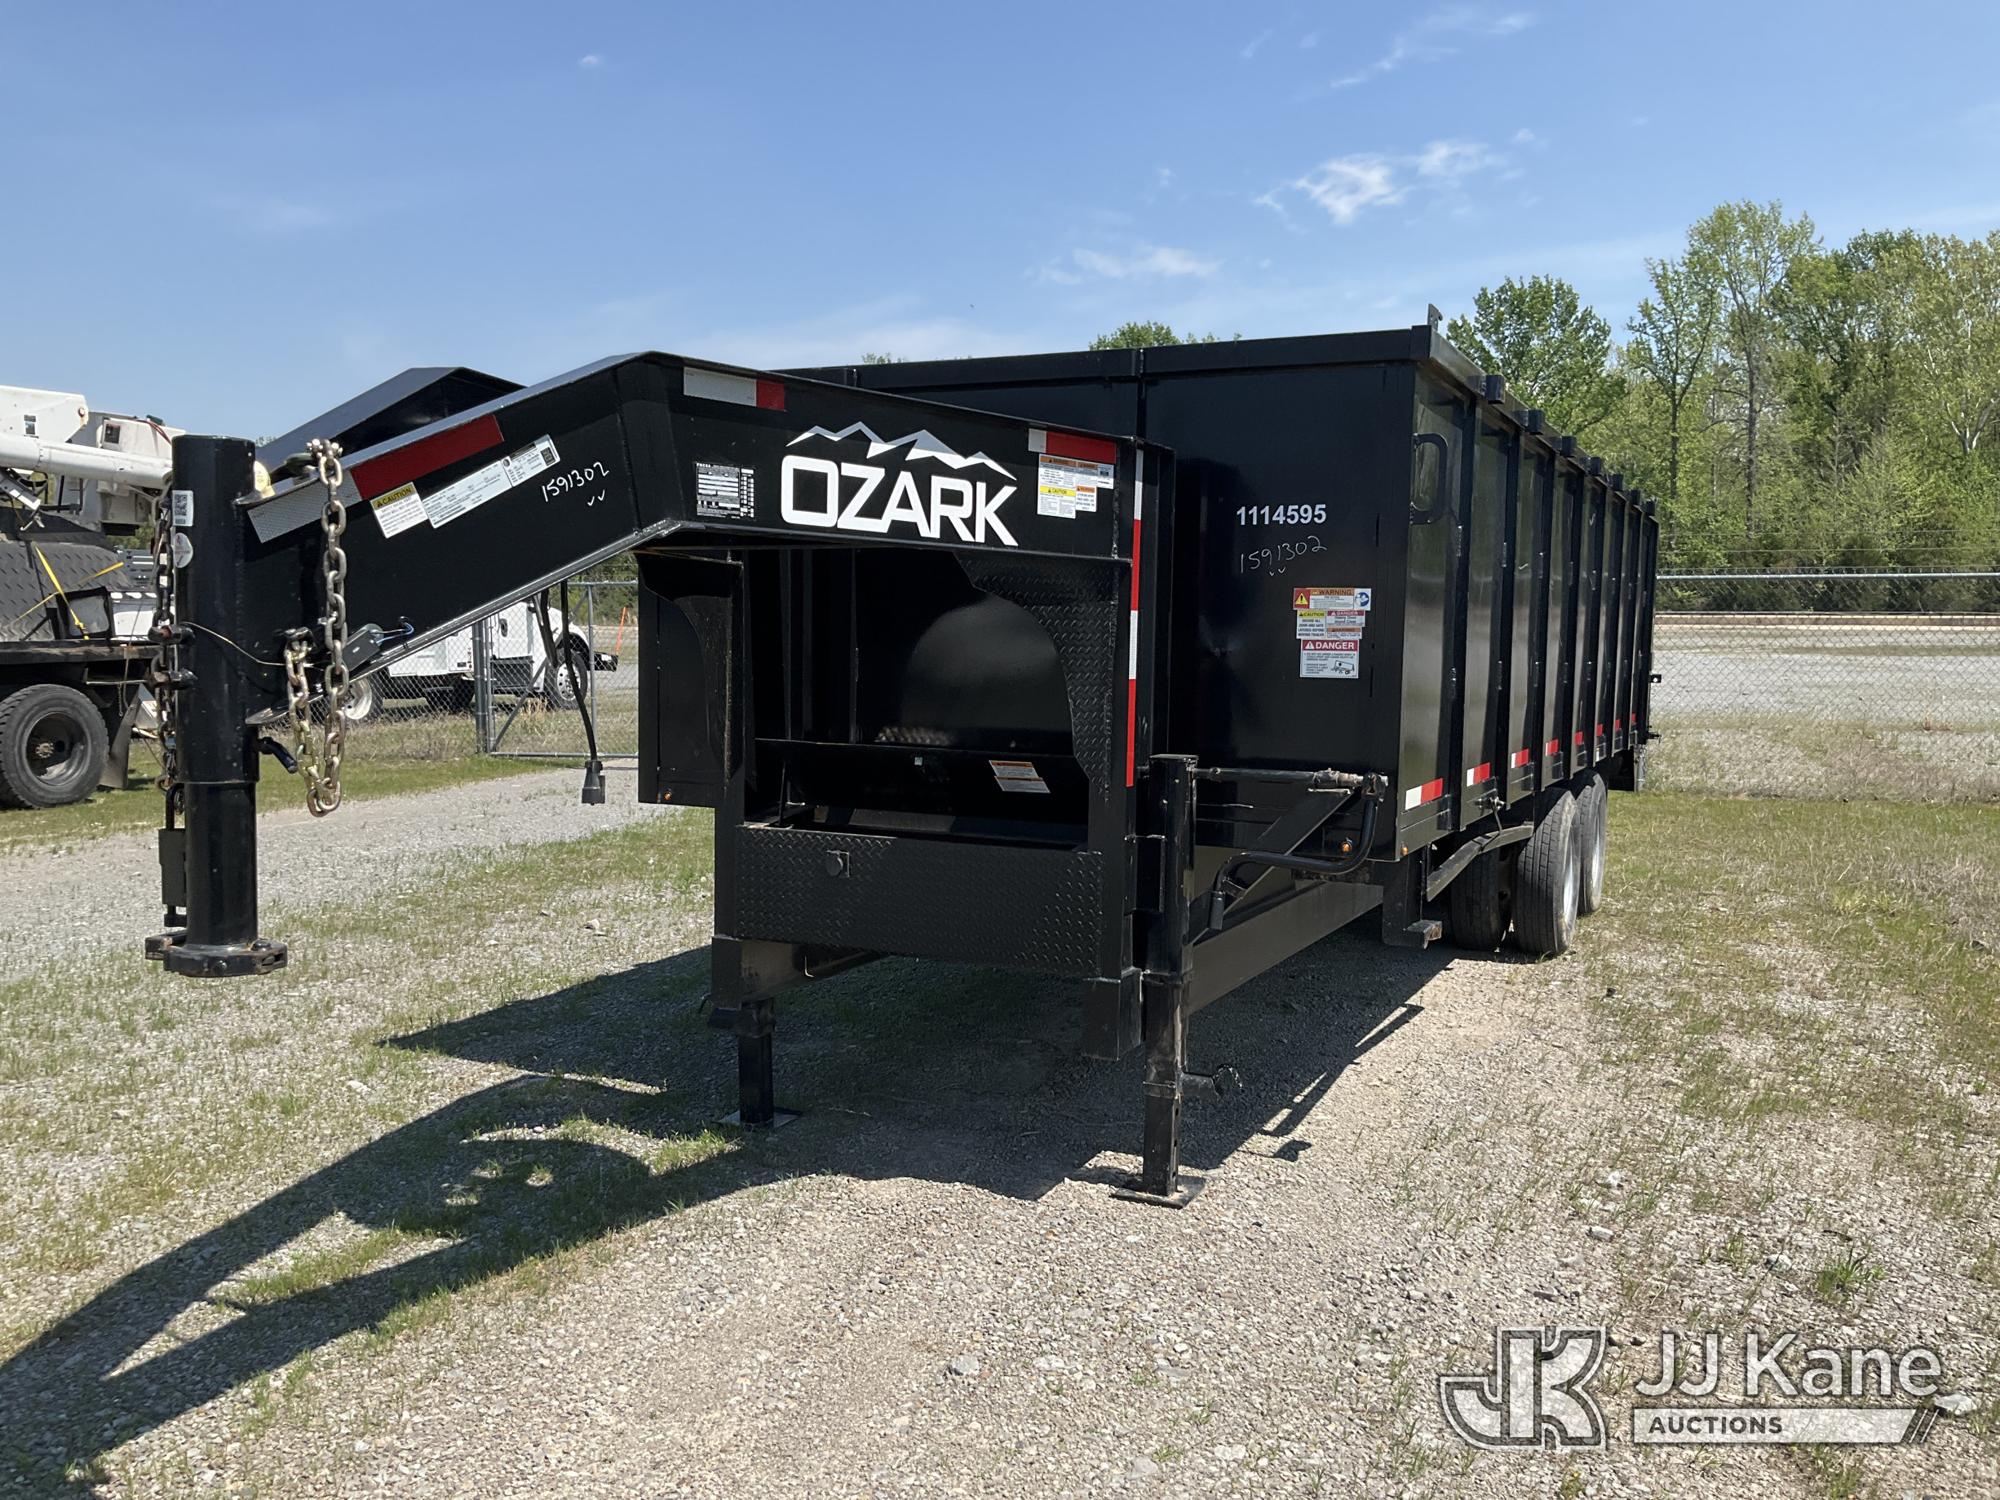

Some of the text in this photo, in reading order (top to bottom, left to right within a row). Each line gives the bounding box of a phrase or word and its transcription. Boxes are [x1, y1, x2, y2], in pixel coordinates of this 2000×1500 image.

[382, 487, 412, 505] CAUTION
[541, 461, 611, 502] 1591302
[780, 454, 1019, 546] OZARK
[1236, 504, 1327, 525] 1114595
[1240, 535, 1327, 573] 1591302
[1315, 641, 1355, 650] DANGER
